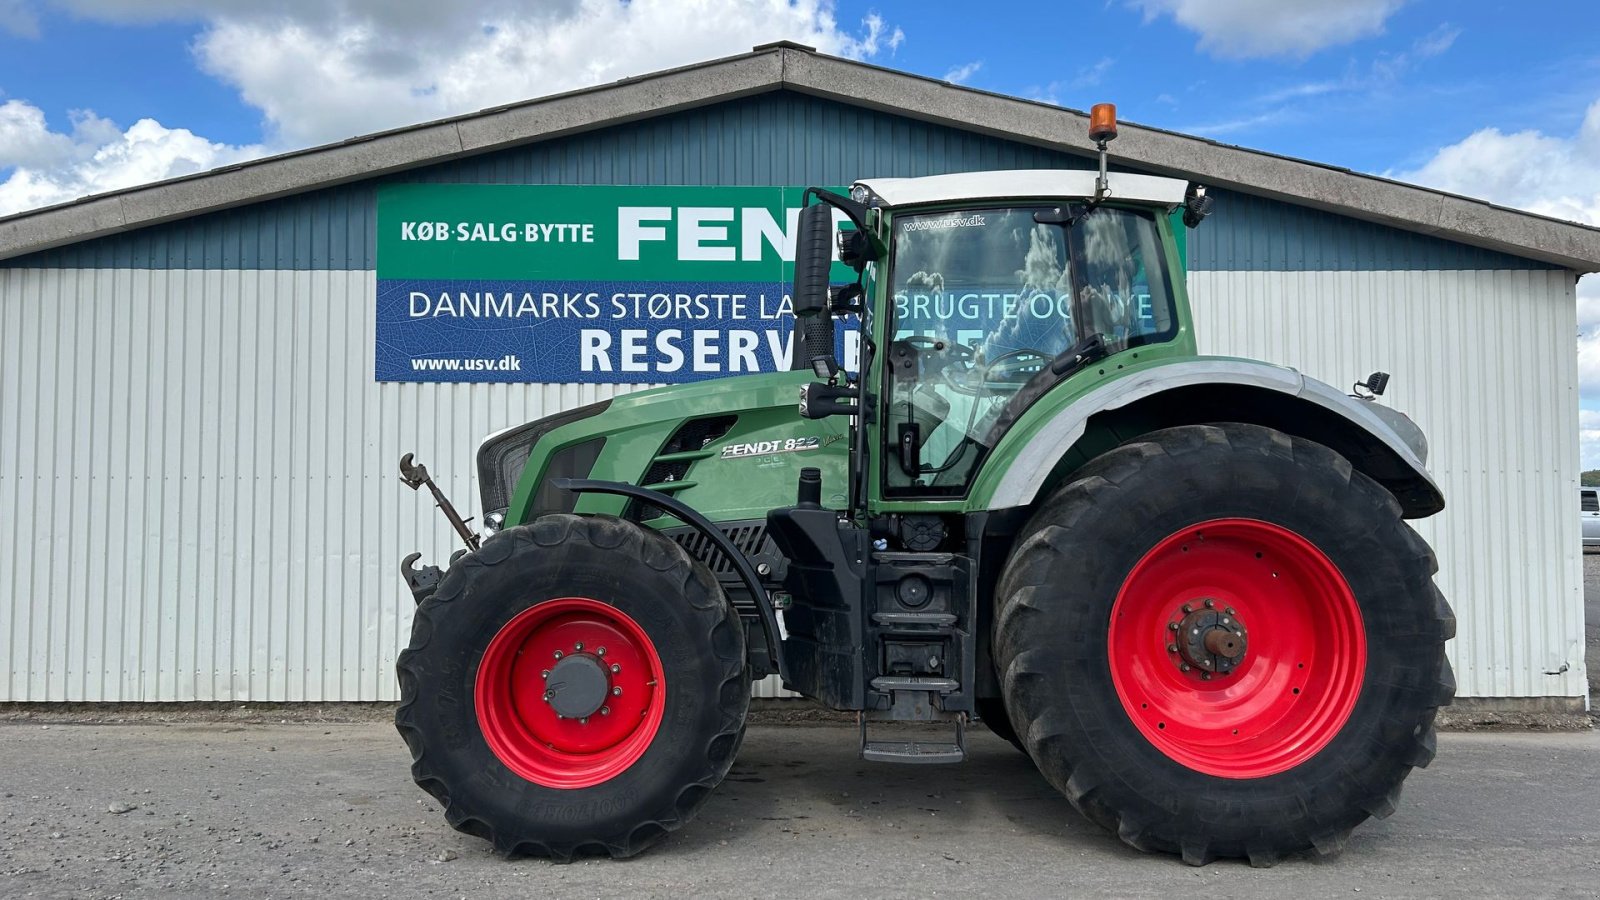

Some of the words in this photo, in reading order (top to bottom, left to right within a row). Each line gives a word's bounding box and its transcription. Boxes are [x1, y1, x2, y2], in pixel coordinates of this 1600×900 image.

[903, 214, 985, 232] www.usv.dk
[617, 206, 859, 262] FEN
[409, 291, 600, 319] DANMARKS
[611, 293, 746, 320] STØRSTE
[894, 293, 1019, 320] BRUGTE
[411, 354, 521, 371] www.usv.dk
[722, 439, 783, 456] FENDT
